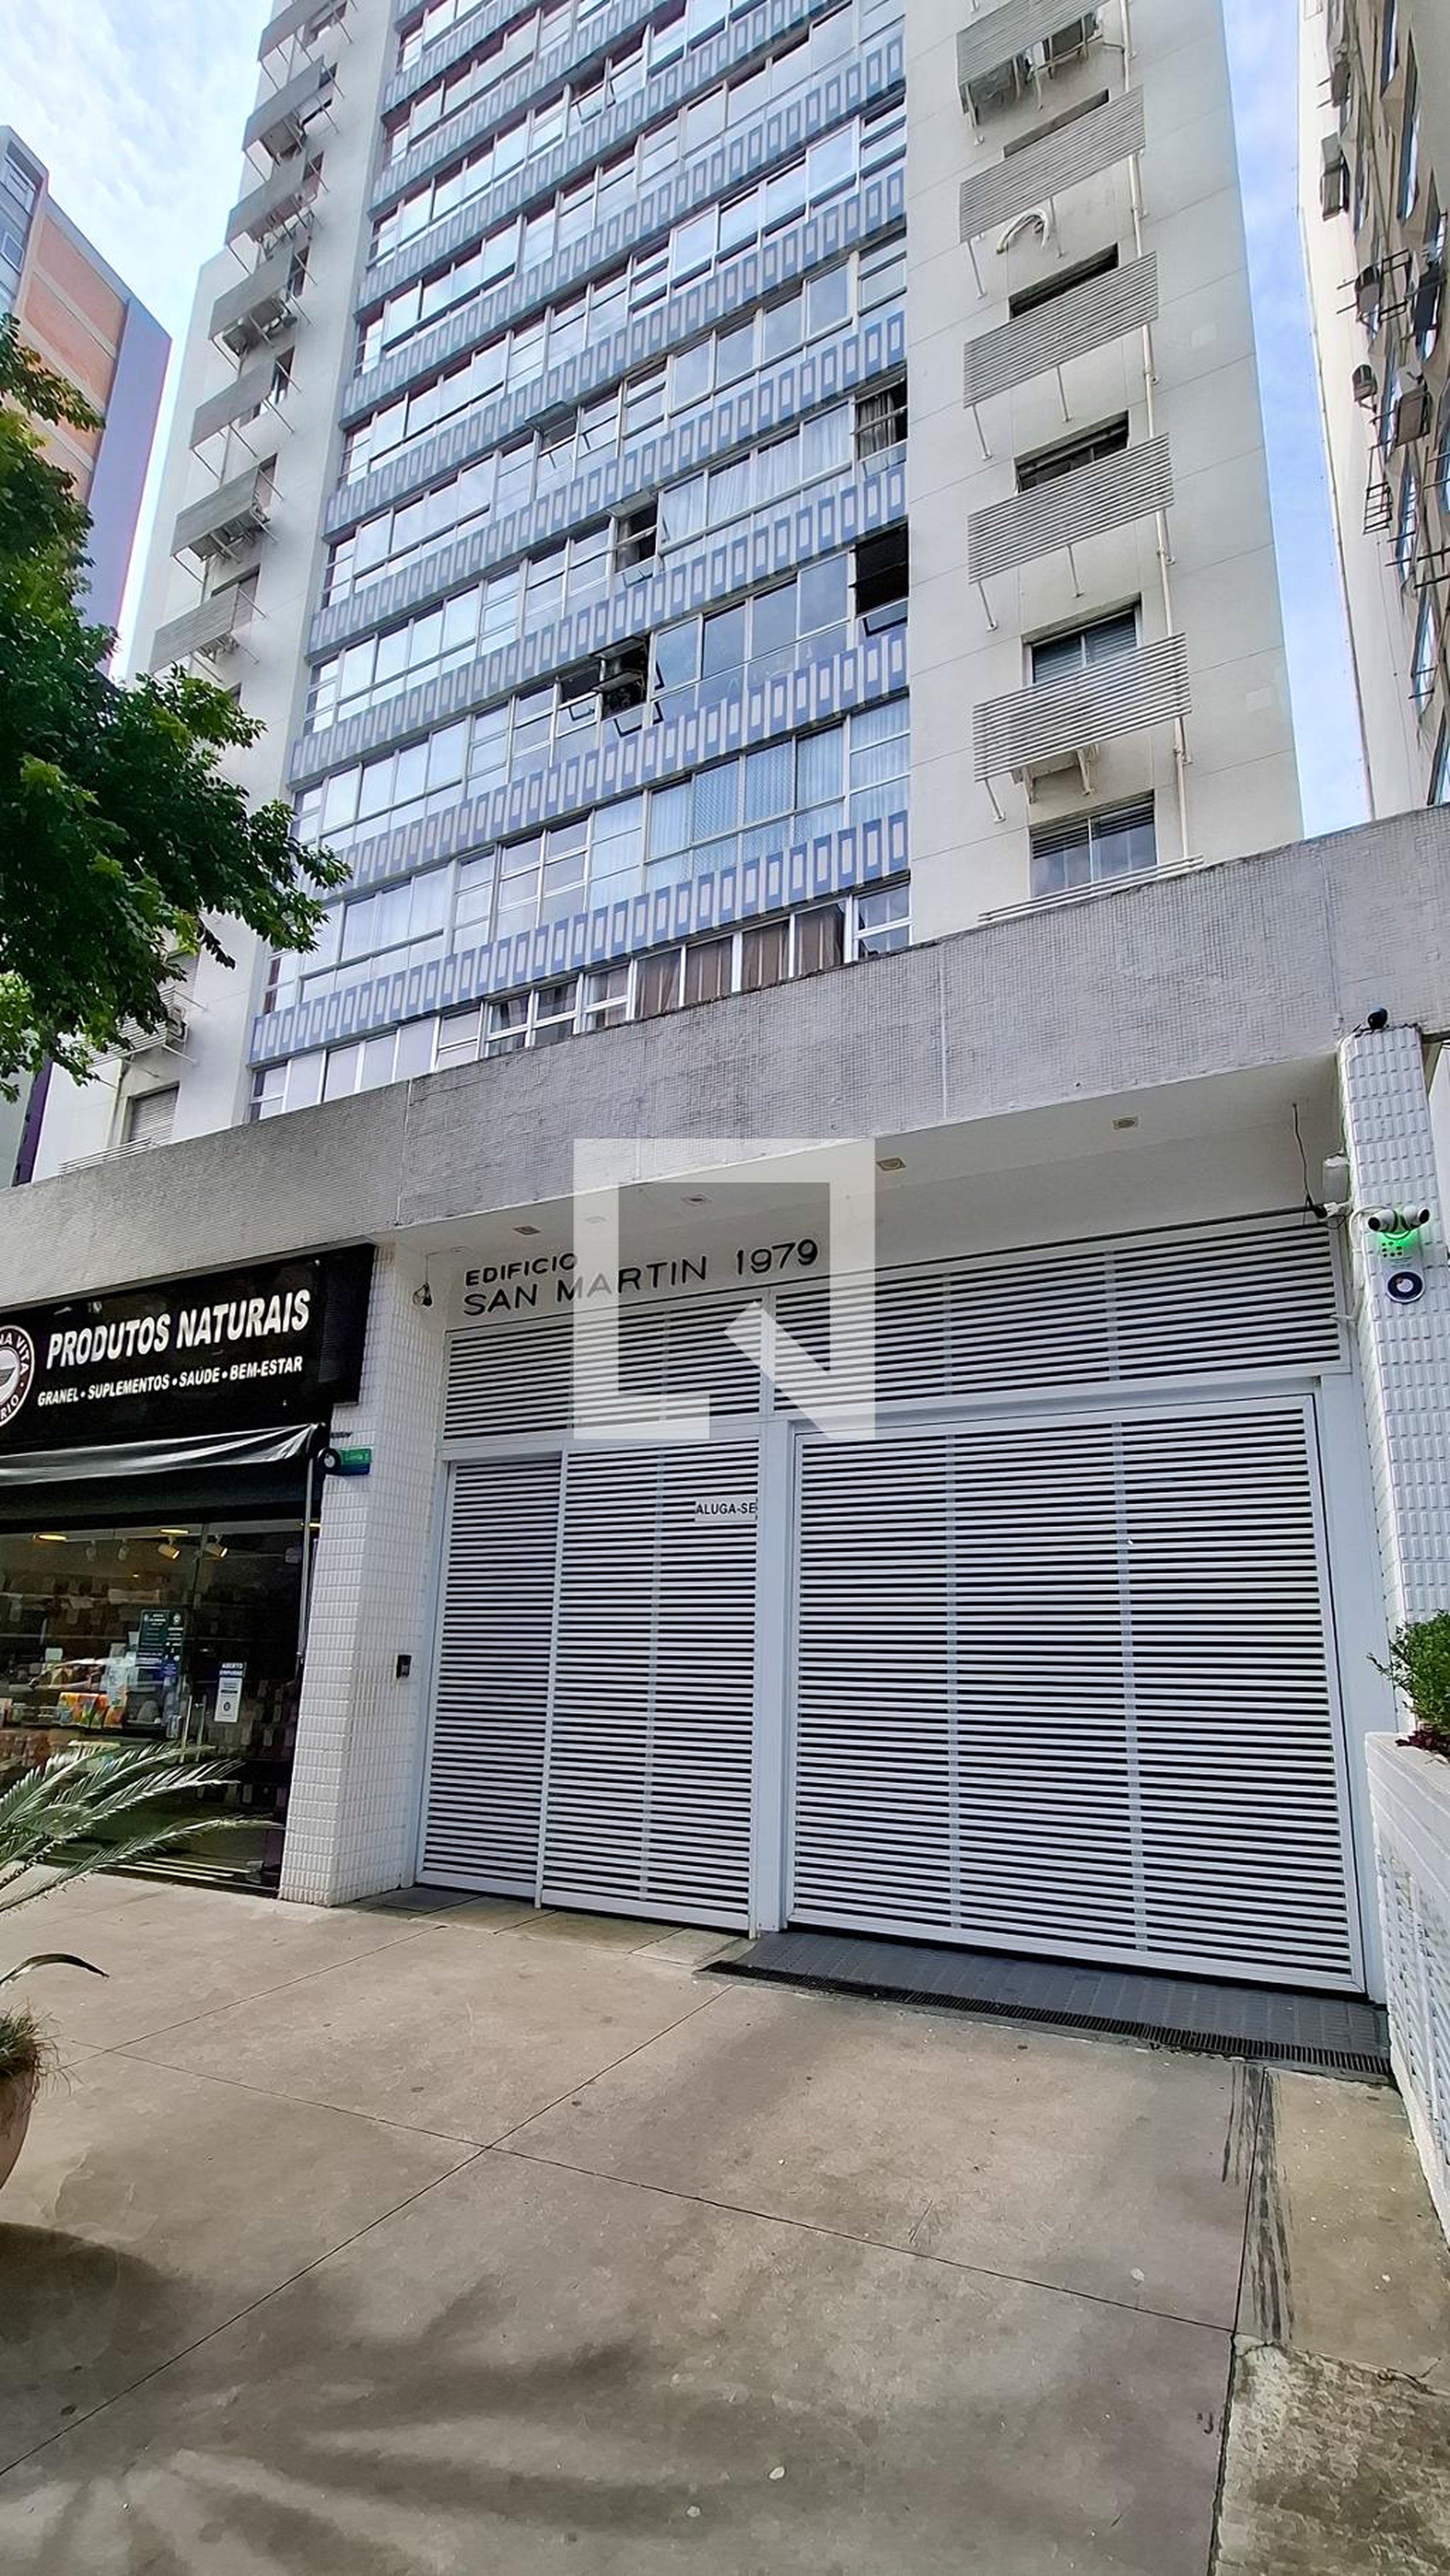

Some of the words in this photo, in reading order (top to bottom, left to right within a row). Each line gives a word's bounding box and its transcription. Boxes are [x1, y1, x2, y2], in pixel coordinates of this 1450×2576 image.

[464, 1284, 537, 1315] SAN
[558, 1256, 706, 1302] MARTIN
[737, 1239, 818, 1275] 1979
[466, 1253, 577, 1286] EDIFICIO
[46, 1313, 170, 1369] PRODUTOS
[176, 1289, 310, 1348] NATURAIS
[38, 1388, 79, 1406] GRANEL
[88, 1374, 170, 1399] SUPLEMENTOS
[230, 1356, 302, 1380] BEM-ESTAR
[696, 1503, 756, 1514] ALUGA-SE
